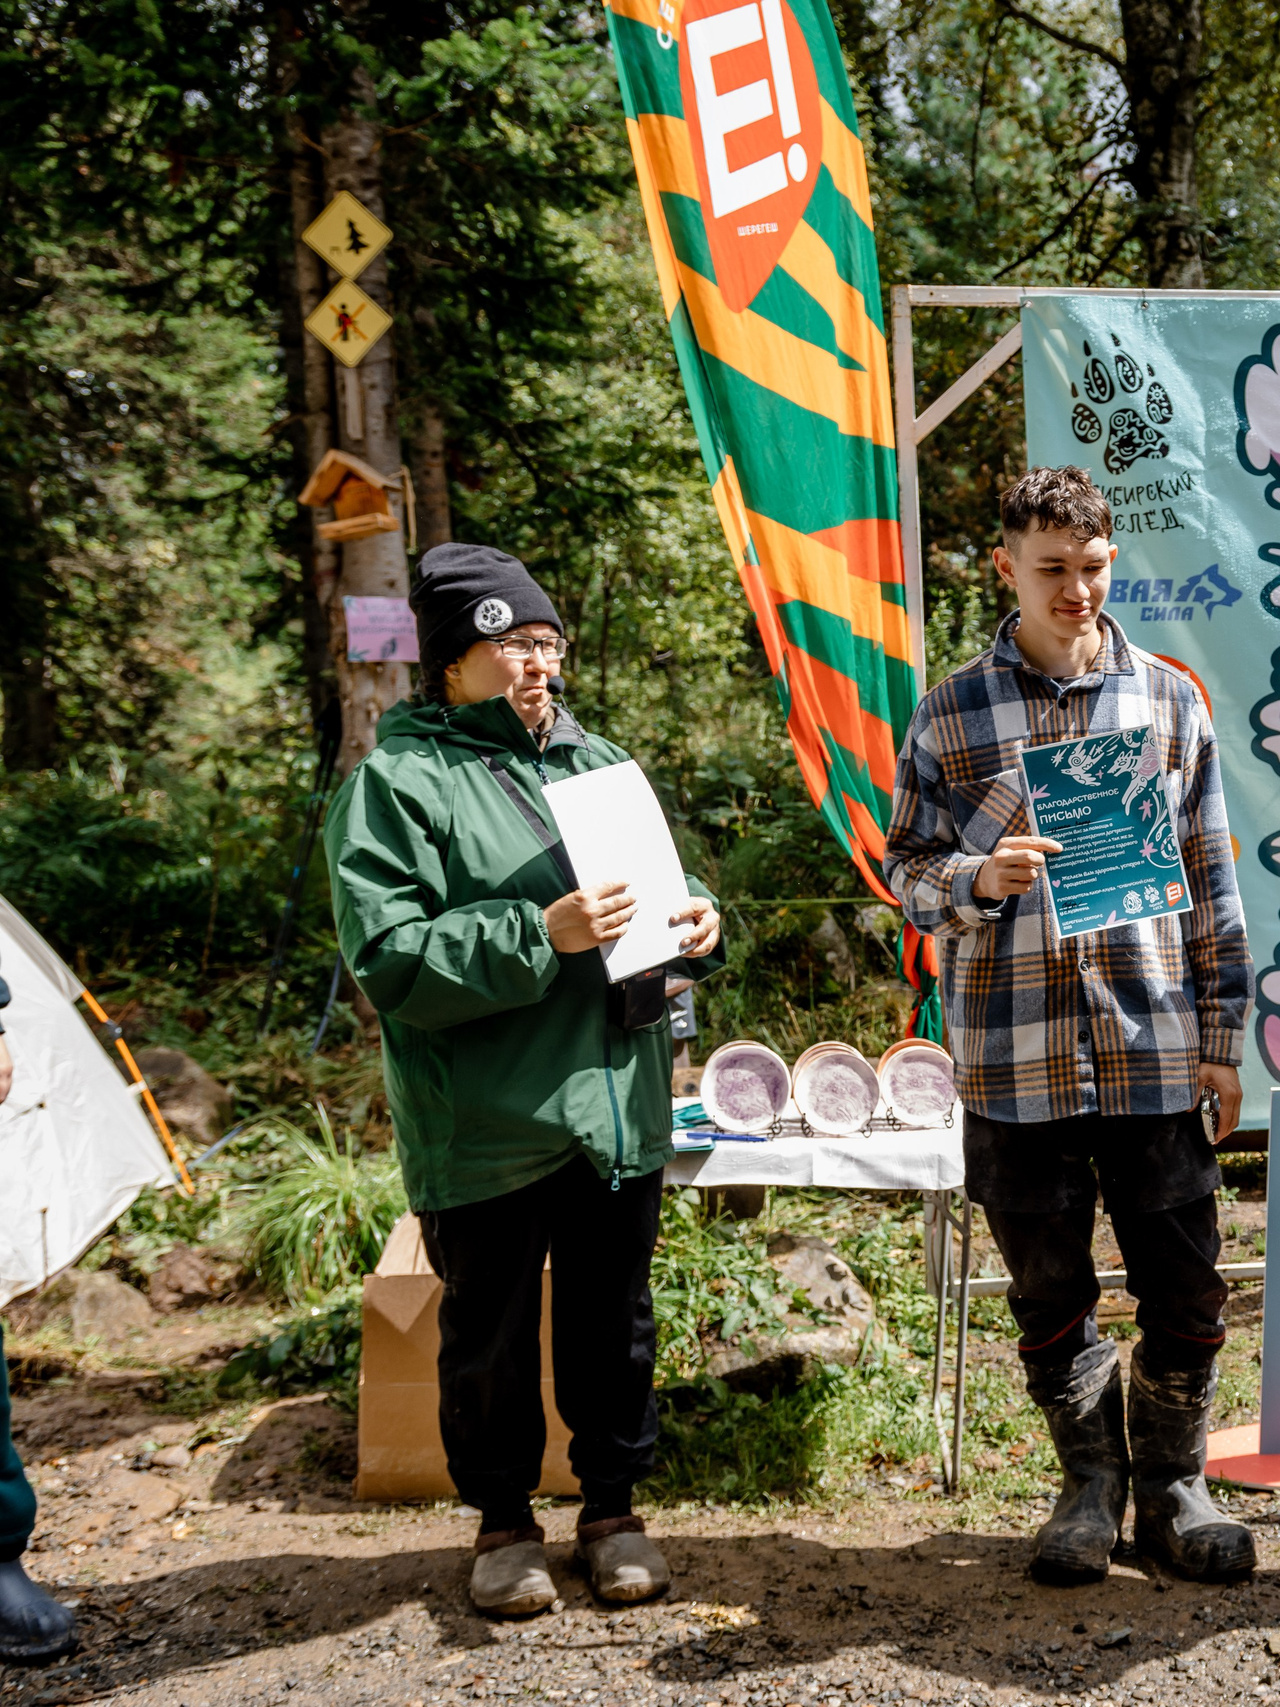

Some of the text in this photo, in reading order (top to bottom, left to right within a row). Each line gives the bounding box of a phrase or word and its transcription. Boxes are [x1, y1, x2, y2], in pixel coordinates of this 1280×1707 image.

[737, 222, 779, 237] ШЕРЕГЕШ
[1098, 471, 1197, 507] ИБИРСКИЙ
[1109, 579, 1174, 603] ВАЯ
[1140, 606, 1194, 622] СИЛА
[1037, 788, 1119, 811] БЛАГОДАРСТВЕННОЕ
[1039, 806, 1092, 825] ПИСЬМО
